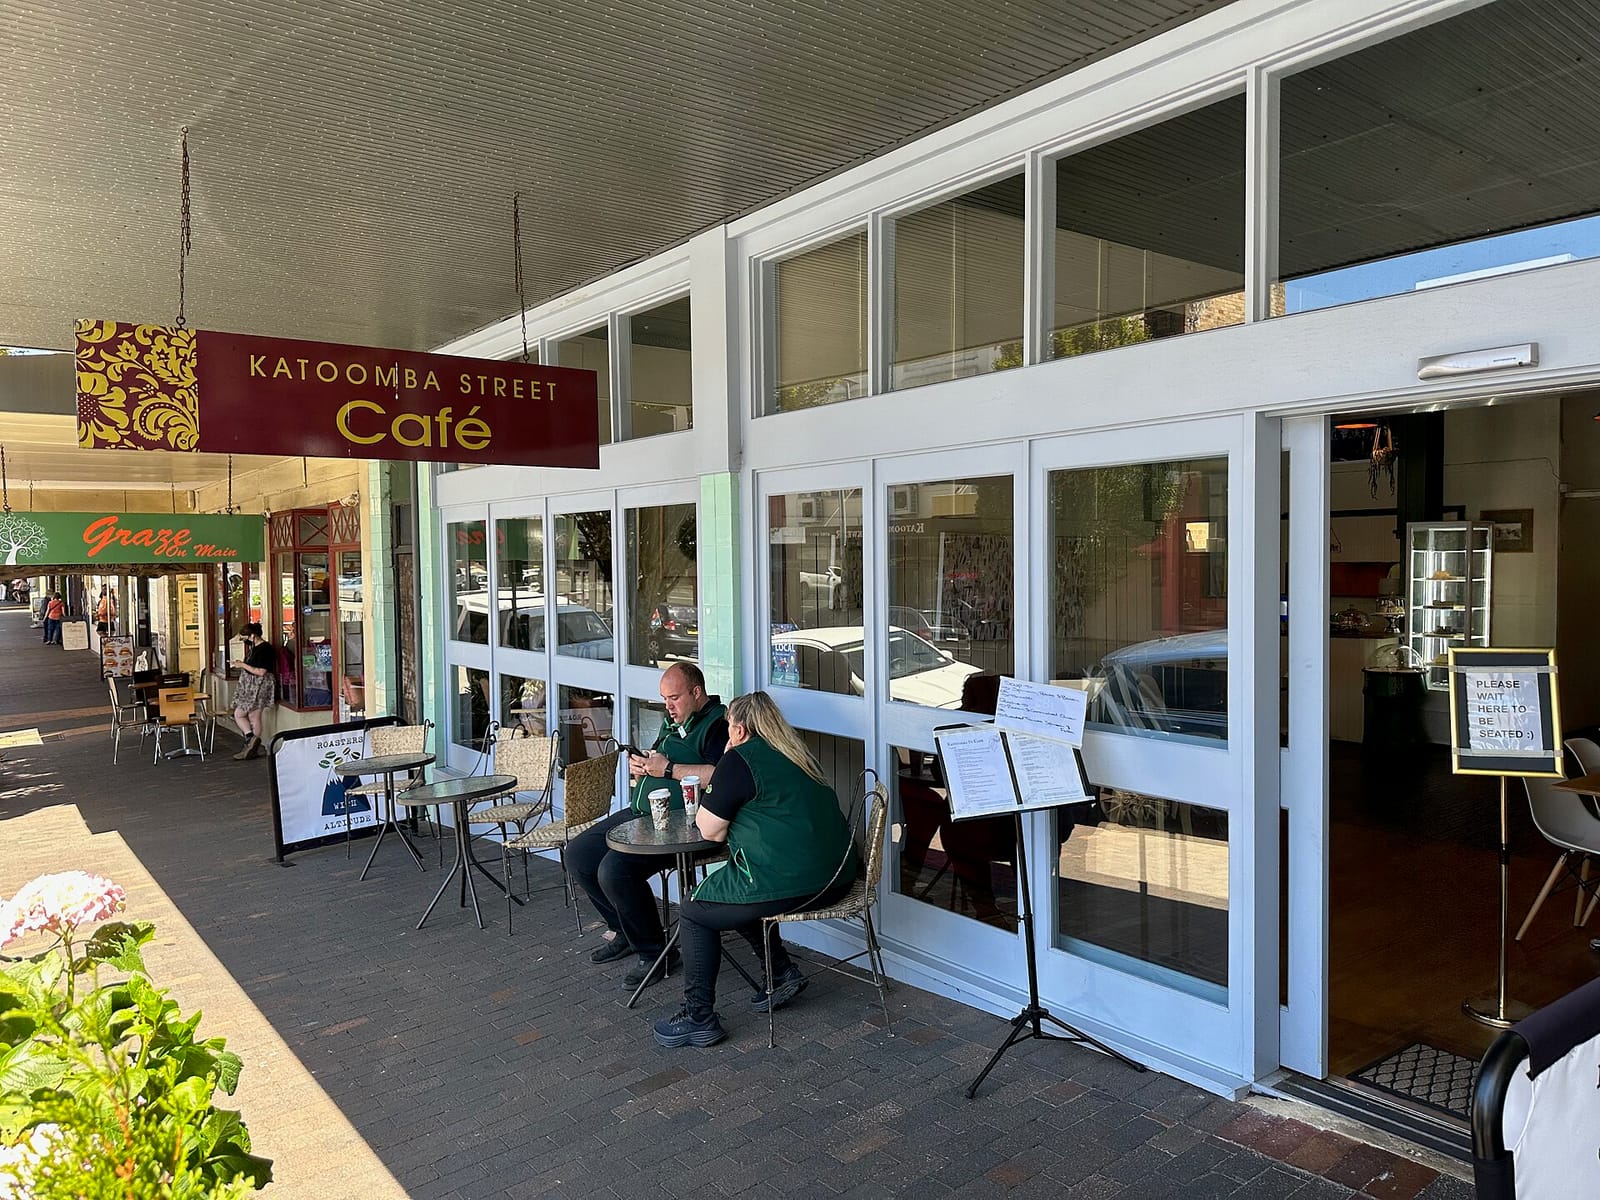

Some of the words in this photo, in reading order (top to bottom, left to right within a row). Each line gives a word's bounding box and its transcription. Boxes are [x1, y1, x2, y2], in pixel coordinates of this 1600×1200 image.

[249, 354, 441, 392] KATOOMBA
[460, 373, 557, 401] STREET
[336, 399, 492, 450] Café
[82, 515, 192, 558] Graze
[165, 545, 187, 558] On
[193, 543, 238, 558] Main
[1476, 680, 1520, 689] PLEASE
[1476, 692, 1505, 701] WAIT
[1478, 705, 1508, 713] HERE
[1512, 705, 1527, 713] TO
[1479, 717, 1494, 726] BE
[1479, 730, 1523, 739] SEATED
[317, 736, 364, 750] ROASTERS
[333, 799, 358, 810] WIH
